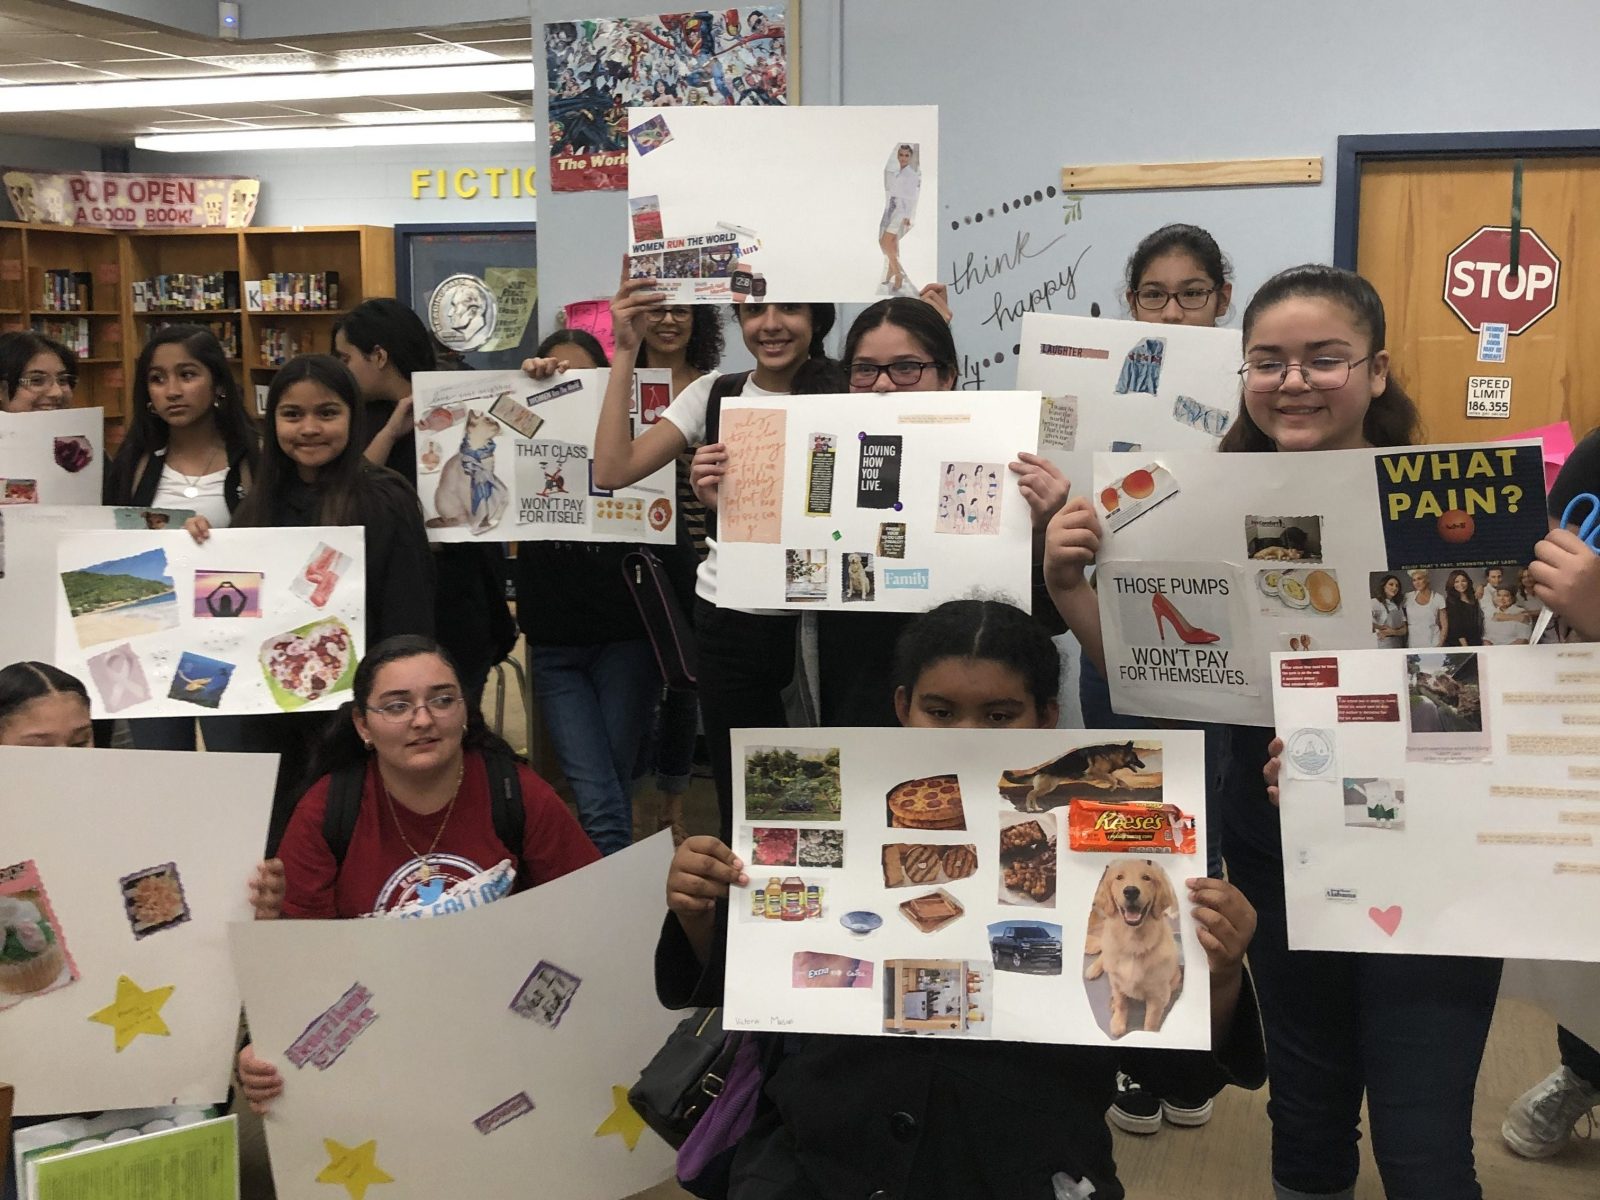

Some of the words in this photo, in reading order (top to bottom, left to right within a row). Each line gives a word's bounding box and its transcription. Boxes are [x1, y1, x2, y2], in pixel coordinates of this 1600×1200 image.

[558, 158, 587, 171] The
[128, 180, 196, 204] OPEN
[77, 207, 88, 221] A
[632, 241, 665, 254] WOMEN
[666, 239, 685, 249] RUN
[687, 236, 704, 246] THE
[705, 233, 737, 244] WORLD
[948, 230, 1066, 294] think
[981, 245, 1092, 331] happy
[1452, 260, 1553, 301] STOP
[250, 289, 261, 308] K
[1042, 343, 1084, 358] LAUGHTER
[1470, 379, 1510, 389] SPEED
[1473, 389, 1506, 399] LIMIT
[516, 444, 549, 456] THAT
[551, 445, 588, 459] CLASS
[863, 445, 896, 456] LOVING
[862, 457, 884, 468] HOW
[1382, 449, 1517, 484] WHAT
[861, 468, 879, 479] YOU
[860, 480, 882, 491] LIVE.
[520, 497, 561, 510] WON'T
[563, 498, 584, 512] PAY
[1388, 484, 1523, 521] PAIN?
[519, 510, 544, 523] FOR
[546, 510, 585, 525] ITSELF.
[885, 571, 928, 588] Family
[1113, 577, 1168, 594] THOSE
[1170, 578, 1230, 596] PUMPS
[1132, 647, 1191, 667] WON'T
[1195, 650, 1229, 669] PAY
[1119, 666, 1148, 681] FOR
[1149, 667, 1249, 686] THEMSELVES.
